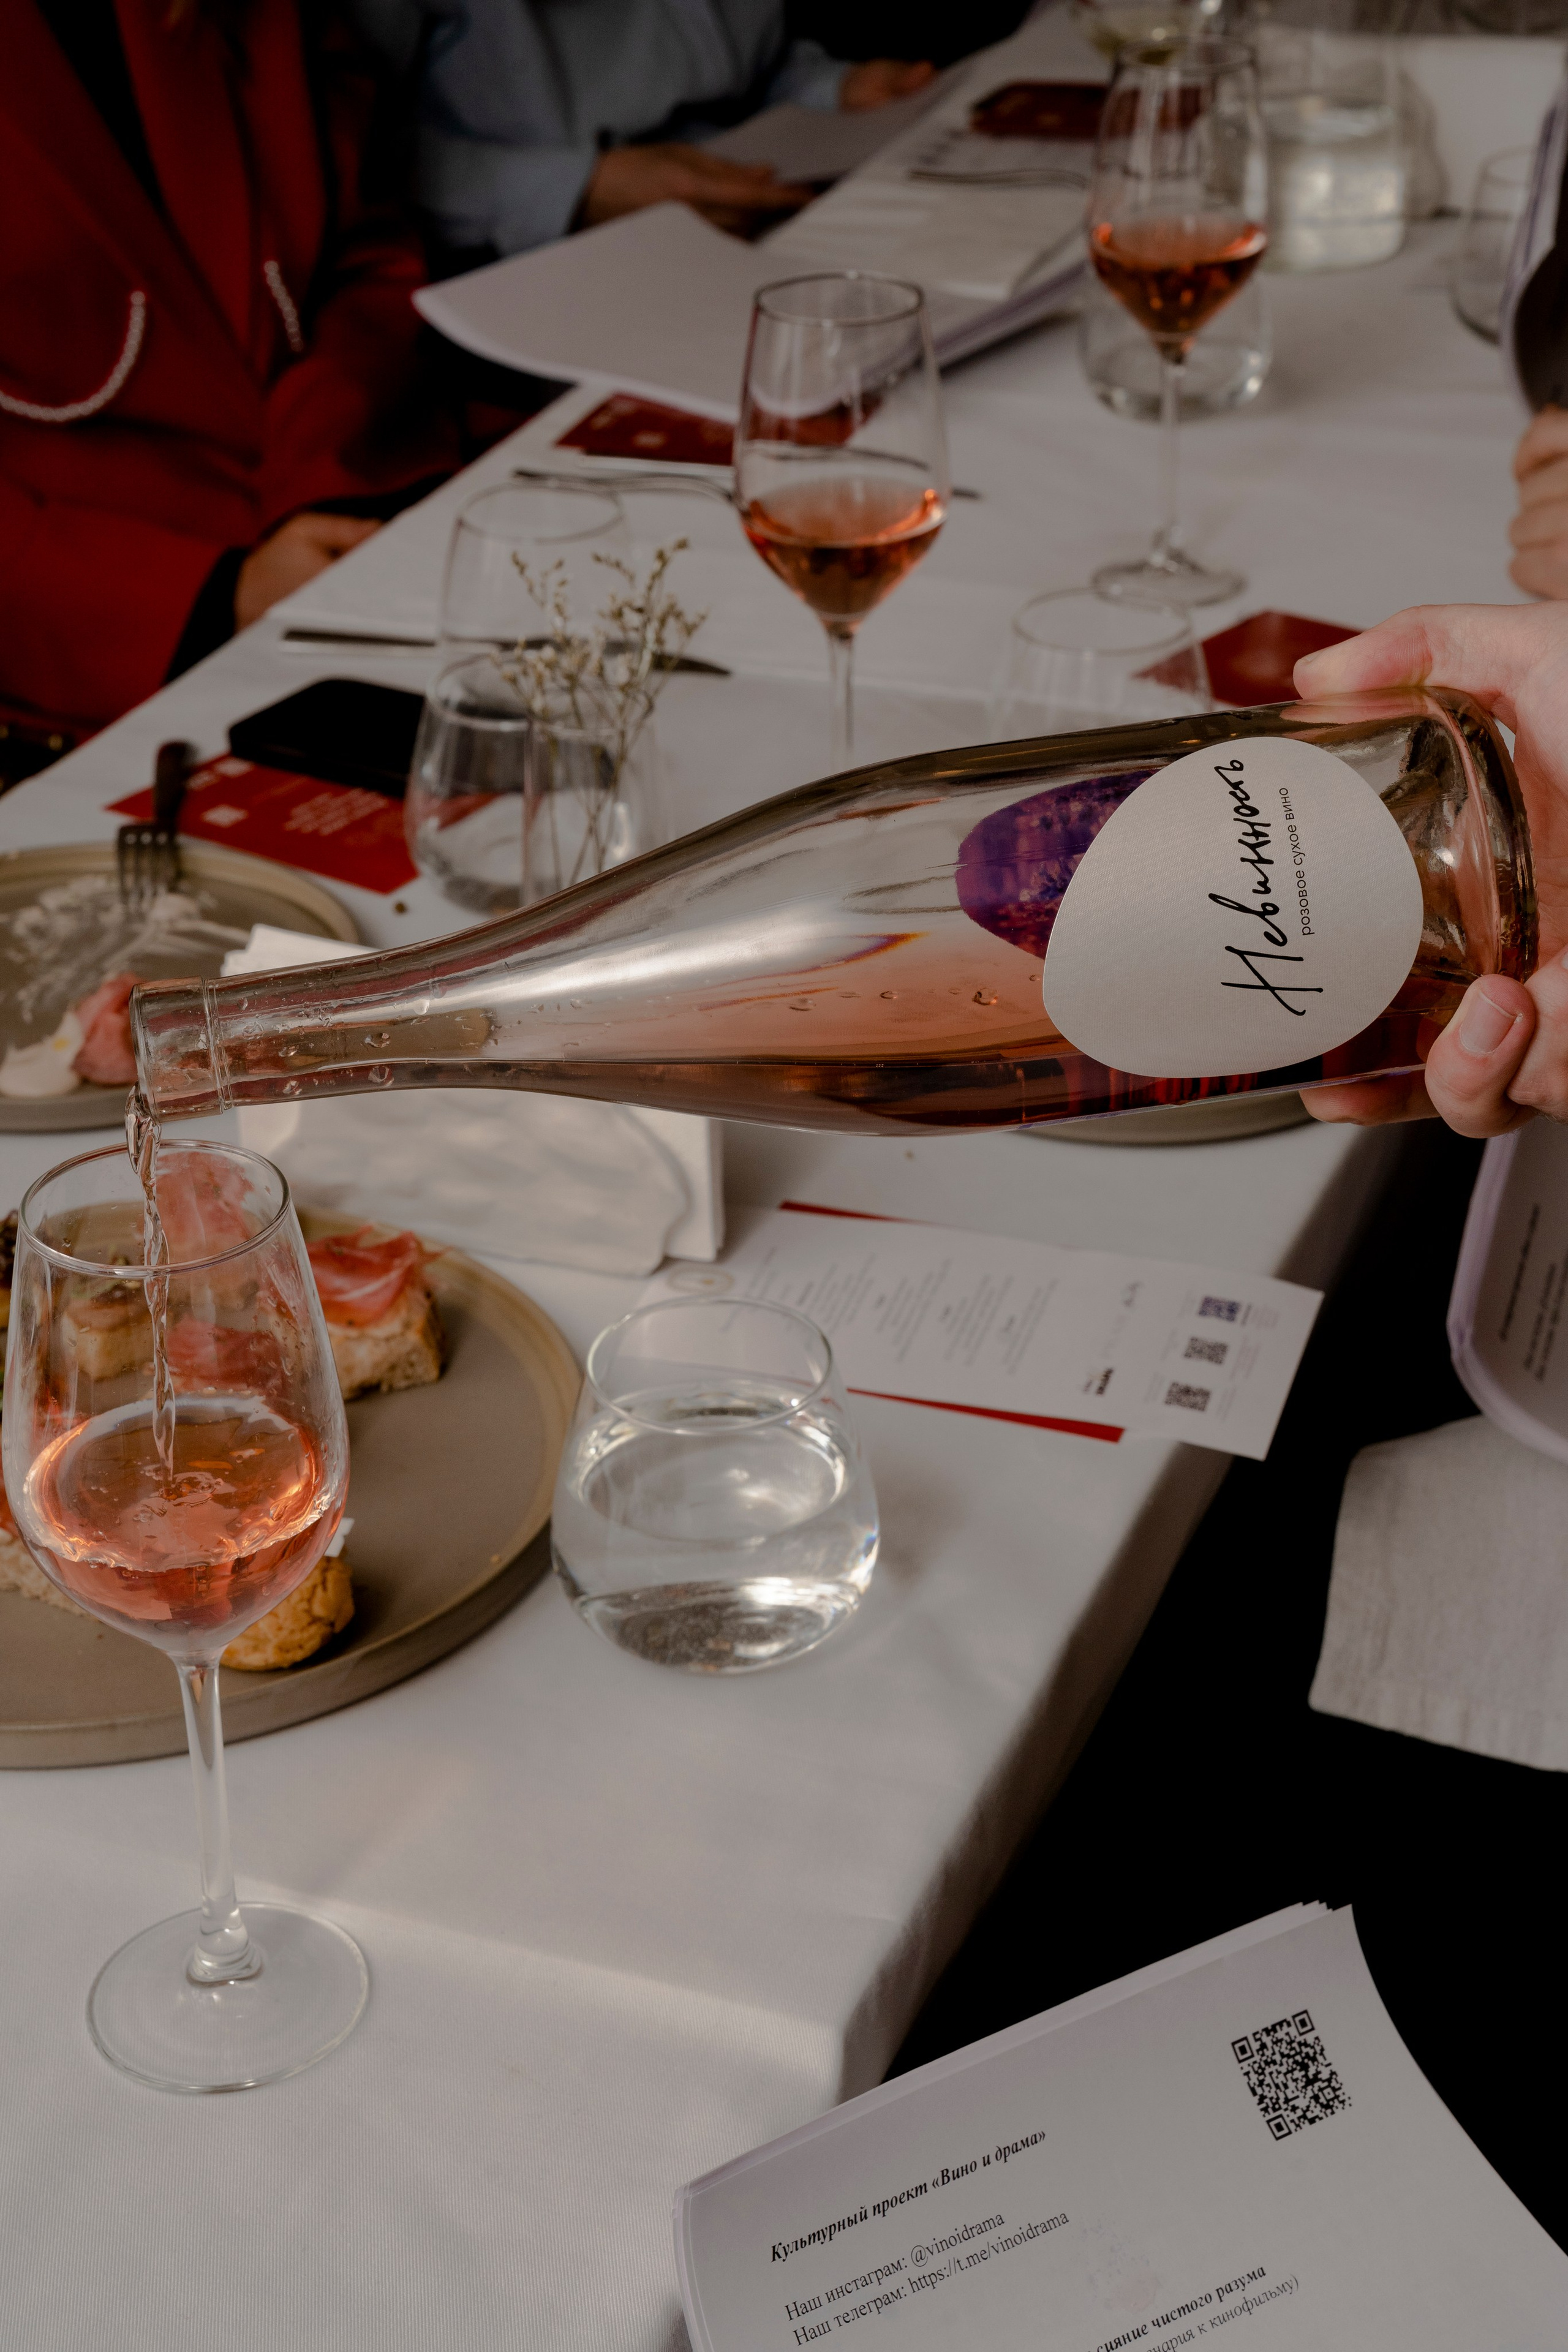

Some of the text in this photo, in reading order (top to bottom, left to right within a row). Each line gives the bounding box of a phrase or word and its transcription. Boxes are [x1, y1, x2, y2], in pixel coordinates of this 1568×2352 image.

[1208, 760, 1324, 1016] Невинность
[1279, 787, 1315, 936] розовое сухое вино
[771, 2130, 1046, 2263] Культурный проект «Вино и драма»
[784, 2212, 1006, 2321] Наш инстаграм: @vinoidrama
[793, 2210, 1069, 2346] Наш телеграм: https://t.me/vinoidrama
[1151, 2293, 1213, 2326] чистого
[1215, 2266, 1267, 2302] разума
[1197, 2323, 1208, 2335] к
[1209, 2274, 1299, 2329] кинофильму)
